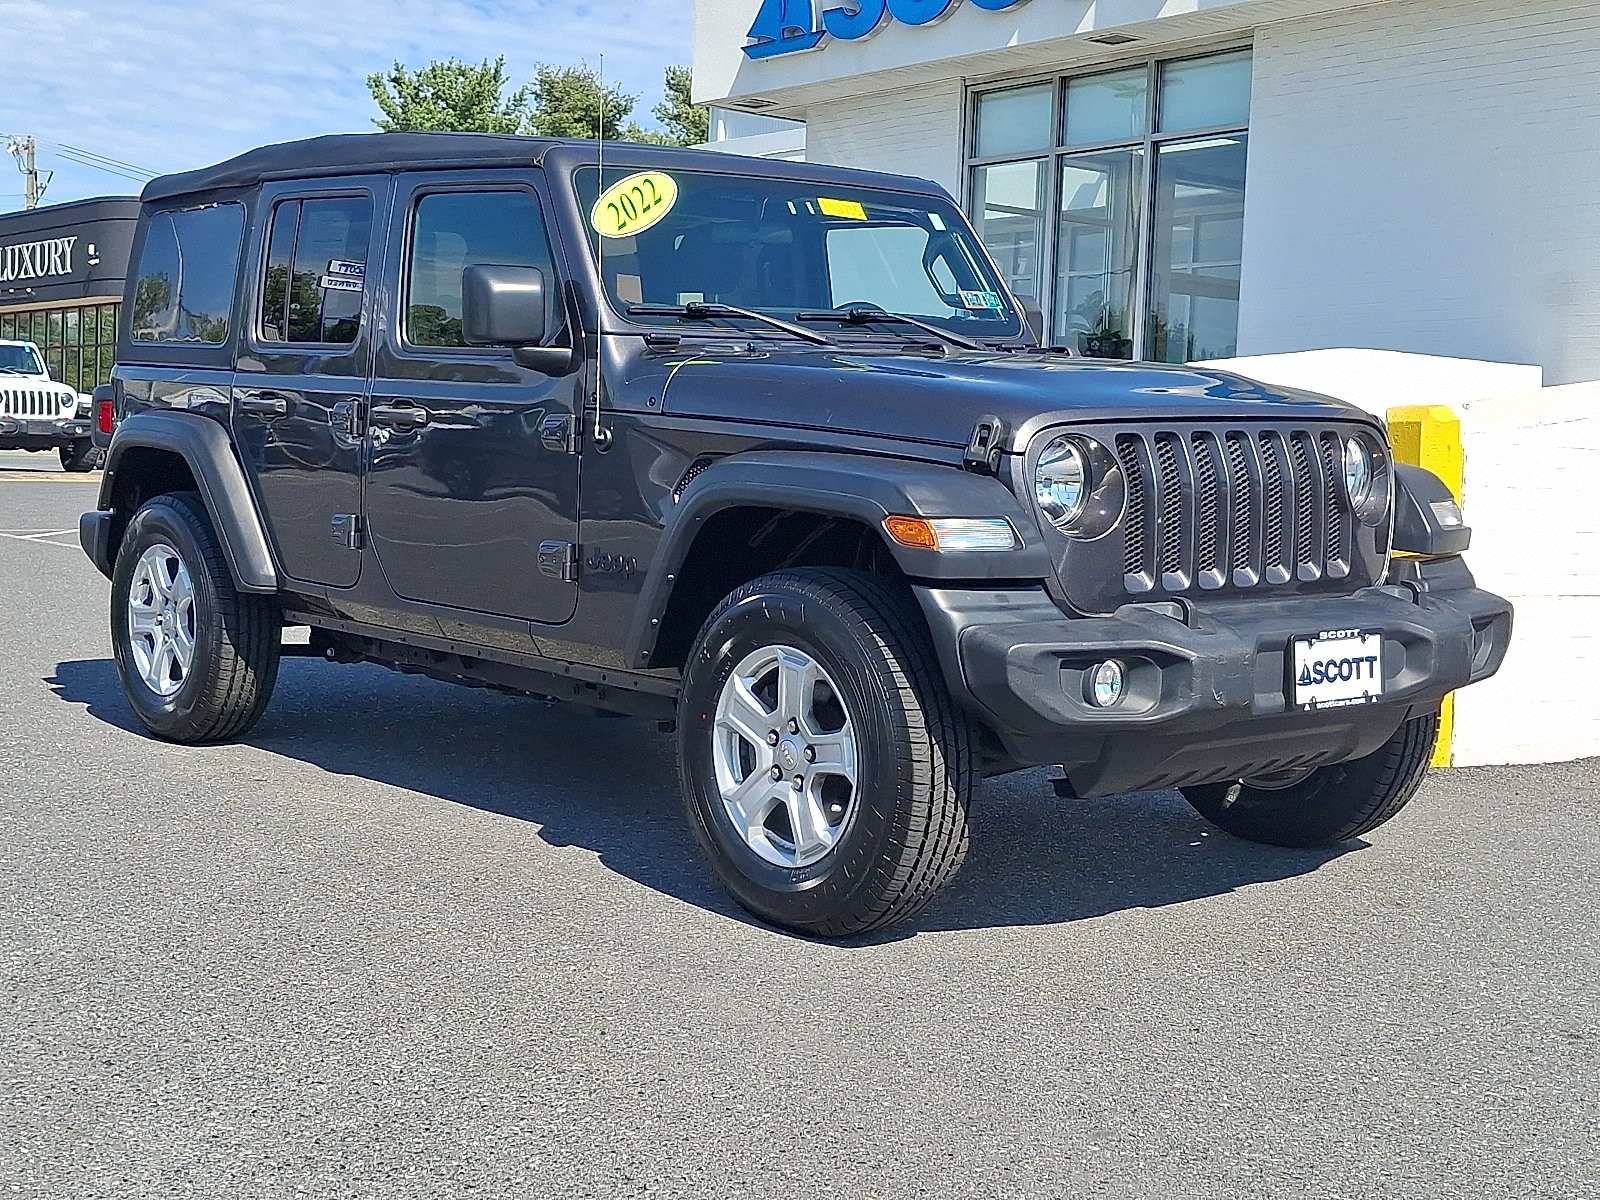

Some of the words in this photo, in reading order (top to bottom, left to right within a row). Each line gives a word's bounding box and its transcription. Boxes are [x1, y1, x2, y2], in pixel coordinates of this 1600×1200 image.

[607, 178, 663, 231] 2022
[0, 236, 78, 281] LUXURY
[586, 546, 638, 580] Jeep
[1320, 628, 1361, 639] SCOTT
[1312, 655, 1378, 685] SCOTT
